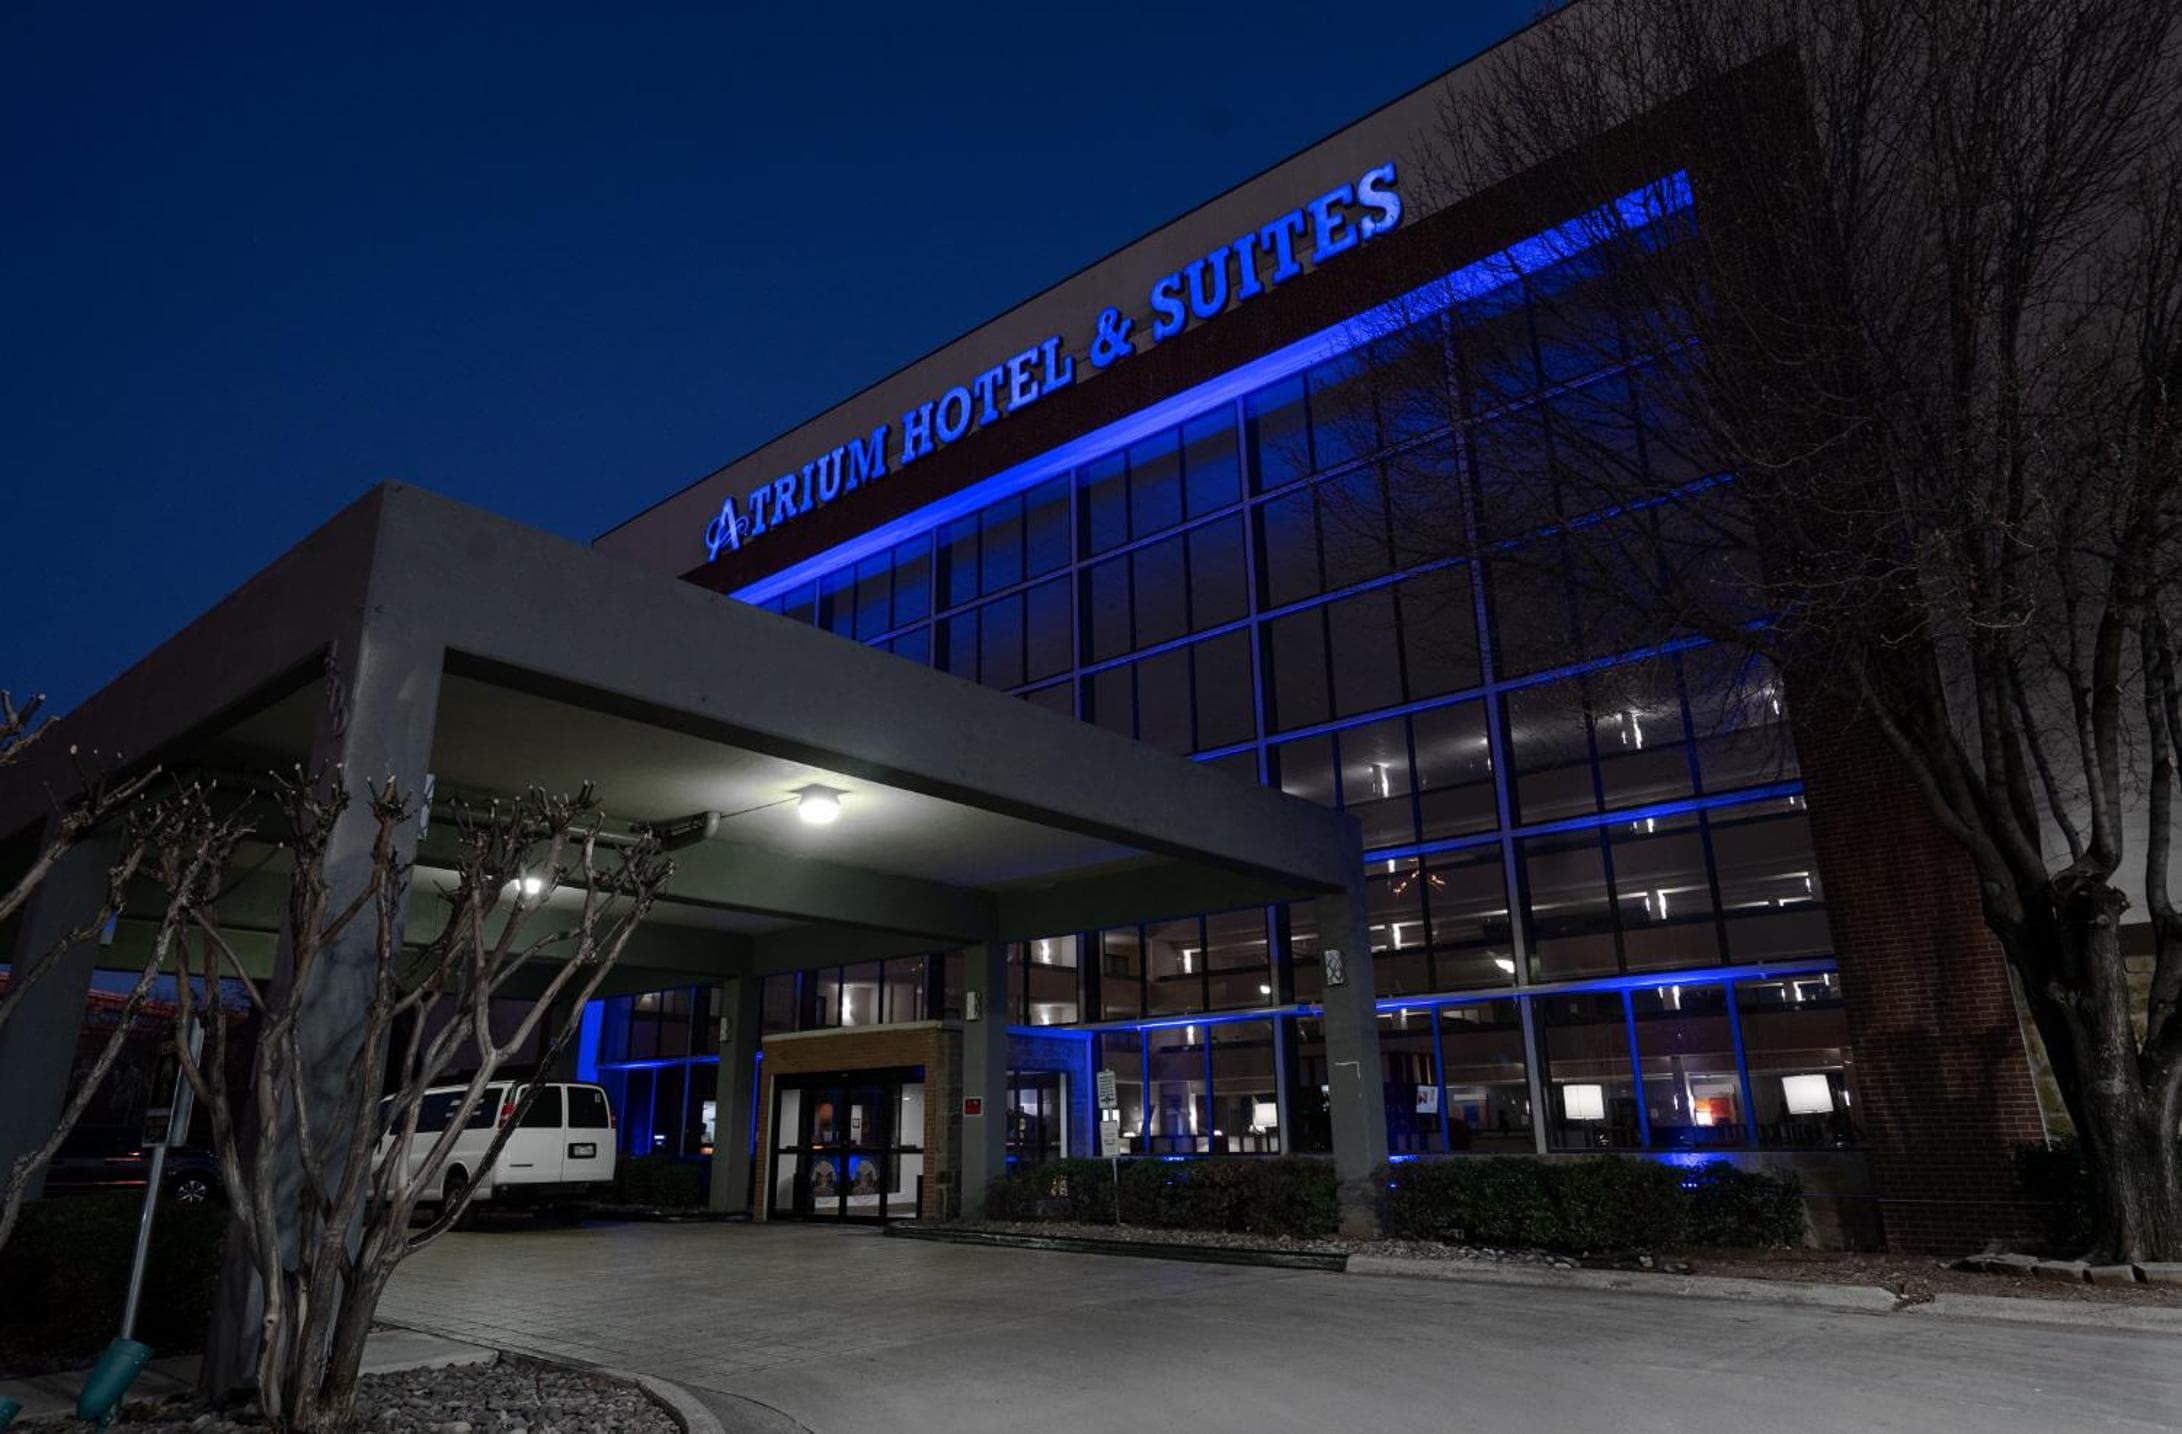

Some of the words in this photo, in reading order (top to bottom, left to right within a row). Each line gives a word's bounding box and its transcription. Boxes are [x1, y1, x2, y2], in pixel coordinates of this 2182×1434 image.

[704, 423, 890, 564] ATRIUM
[901, 335, 1076, 467] HOTEL
[1089, 306, 1136, 370] &
[1150, 161, 1404, 344] SUITES
